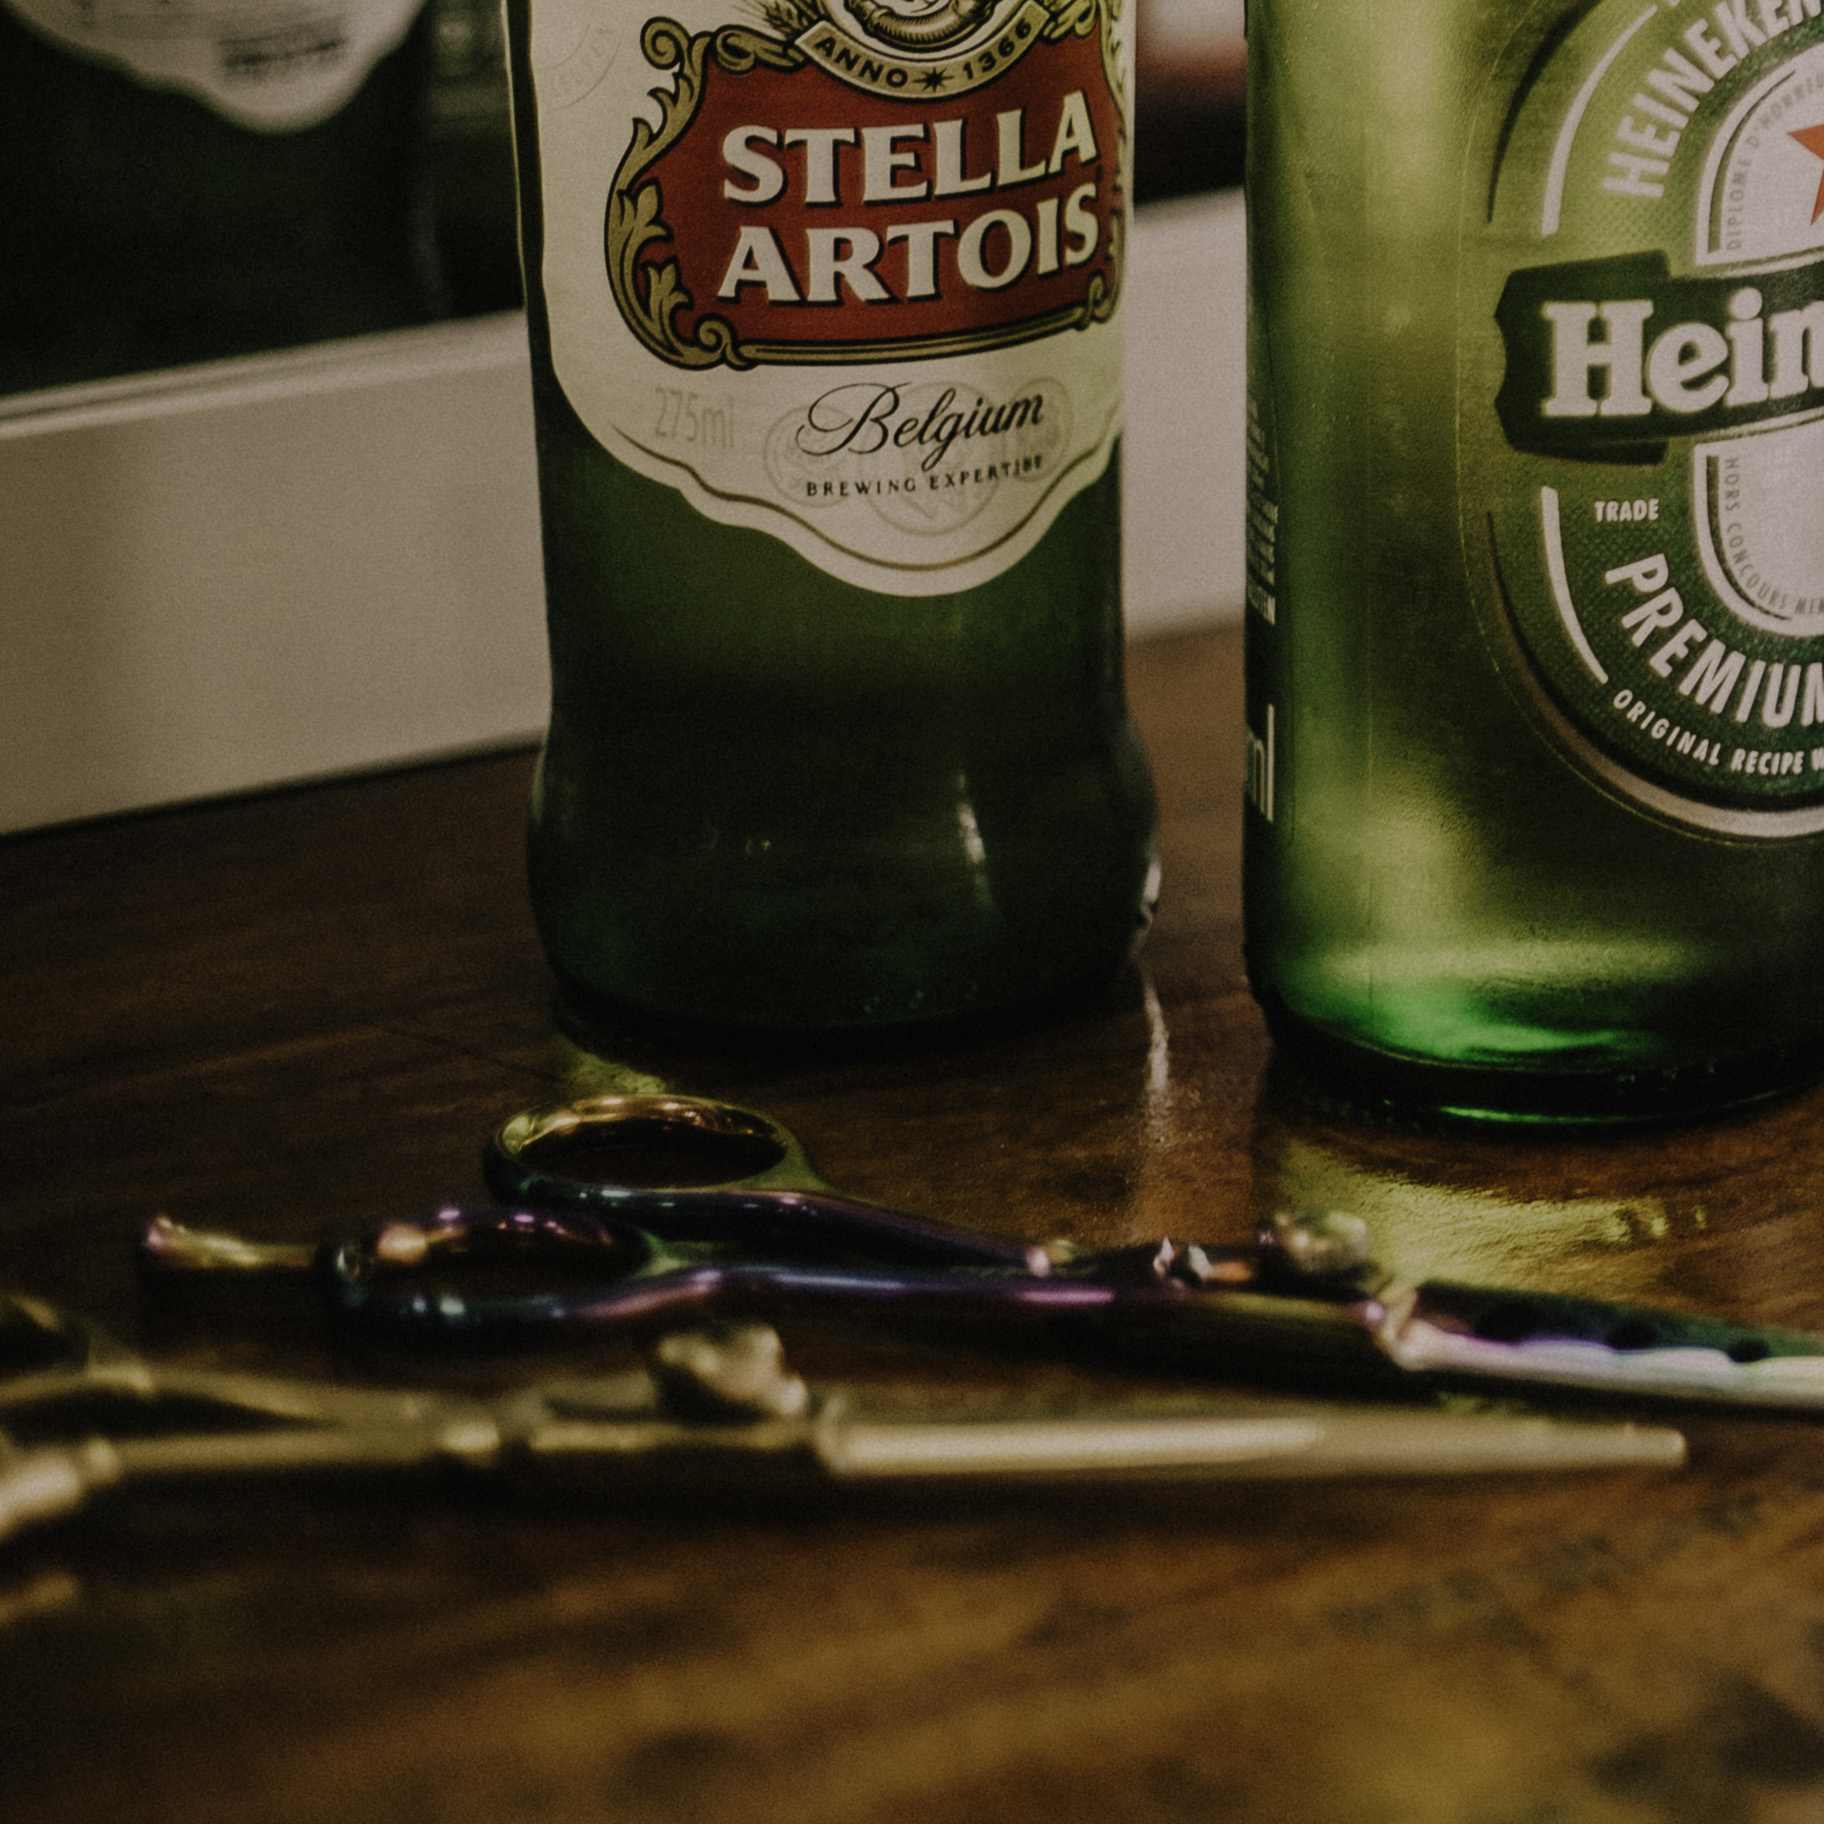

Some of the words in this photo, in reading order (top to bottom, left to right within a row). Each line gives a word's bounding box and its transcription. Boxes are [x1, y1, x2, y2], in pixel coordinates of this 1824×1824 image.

[814, 36, 909, 89] ANNO
[962, 20, 1033, 80] 1366
[720, 89, 1098, 206] STELLA
[717, 183, 1100, 304] ARTOIS
[654, 385, 736, 450] 275ml
[794, 381, 1044, 473] Belgium
[806, 478, 918, 499] BREWING
[1593, 497, 1660, 523] TRADE
[1612, 688, 1722, 767] ORIGINAL
[1730, 748, 1806, 776] RECIPE
